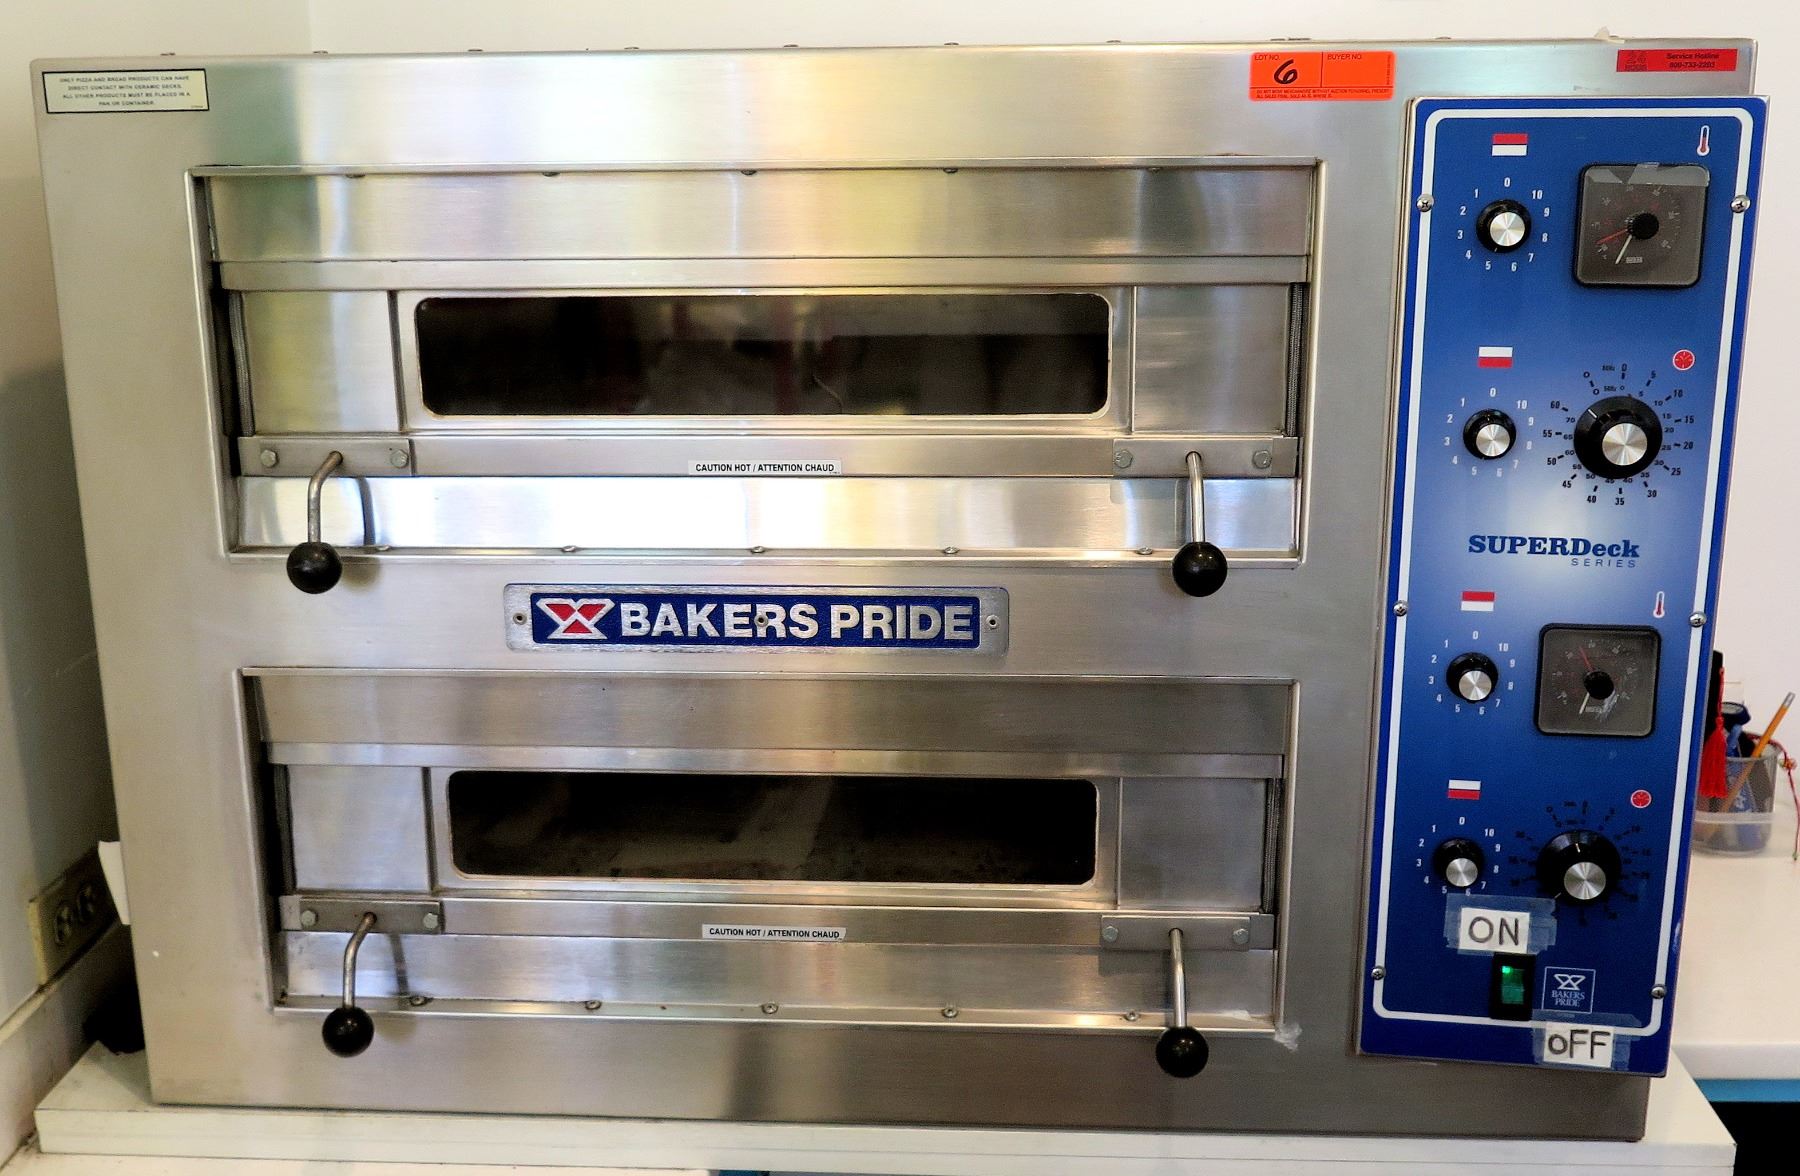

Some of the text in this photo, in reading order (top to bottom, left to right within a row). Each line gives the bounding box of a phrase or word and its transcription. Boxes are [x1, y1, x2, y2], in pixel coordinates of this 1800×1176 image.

[1274, 59, 1298, 84] 6
[1504, 177, 1510, 187] 0
[1474, 188, 1478, 198] 1
[1532, 190, 1542, 199] 10
[1460, 206, 1466, 215] 2
[1544, 208, 1550, 217] 9
[1457, 230, 1463, 239] 3
[1542, 233, 1548, 242] 8
[1465, 250, 1472, 259] 4
[1528, 253, 1534, 262] 7
[1485, 261, 1491, 270] 5
[1511, 262, 1517, 272] 6
[1651, 370, 1656, 378] 5
[1490, 388, 1496, 397] 0
[1674, 389, 1683, 398] 10
[1461, 398, 1465, 407] 1
[1516, 400, 1527, 410] 10
[1447, 414, 1453, 423] 2
[1528, 417, 1534, 426] 9
[1685, 415, 1694, 424] 15
[1444, 437, 1450, 446] 3
[1683, 442, 1693, 450] 20
[1452, 456, 1458, 464] 4
[1513, 460, 1519, 469] 7
[1547, 457, 1557, 465] 50
[696, 464, 732, 472] CAUTION
[735, 464, 750, 472] HOT
[758, 464, 802, 472] ATTENTION
[805, 464, 834, 472] CHAUD
[1472, 466, 1477, 475] 5
[1496, 468, 1502, 477] 6
[1468, 535, 1640, 558] SUPERDeck
[1571, 558, 1636, 568] SERIES
[620, 602, 974, 640] BAKERS PRIDE
[1472, 630, 1478, 639] 0
[1444, 640, 1448, 648] 1
[1499, 643, 1508, 652] 10
[1431, 655, 1438, 664] 2
[1510, 659, 1515, 668] 9
[1428, 676, 1434, 684] 3
[1508, 682, 1514, 690] 8
[1436, 694, 1442, 702] 4
[1496, 699, 1500, 708] 7
[1455, 704, 1460, 713] 5
[1479, 706, 1485, 715] 6
[1459, 816, 1465, 825] 0
[1432, 825, 1436, 833] 1
[1484, 828, 1495, 837] 10
[1418, 838, 1424, 847] 2
[1495, 844, 1501, 852] 9
[1416, 858, 1422, 867] 3
[1493, 865, 1499, 873] 8
[1424, 876, 1429, 884] 4
[1442, 886, 1447, 894] 5
[1481, 881, 1487, 890] 7
[1465, 888, 1471, 896] 6
[1468, 916, 1519, 946] ON
[1552, 990, 1585, 1000] BAKERS
[1555, 998, 1580, 1007] PRIDE
